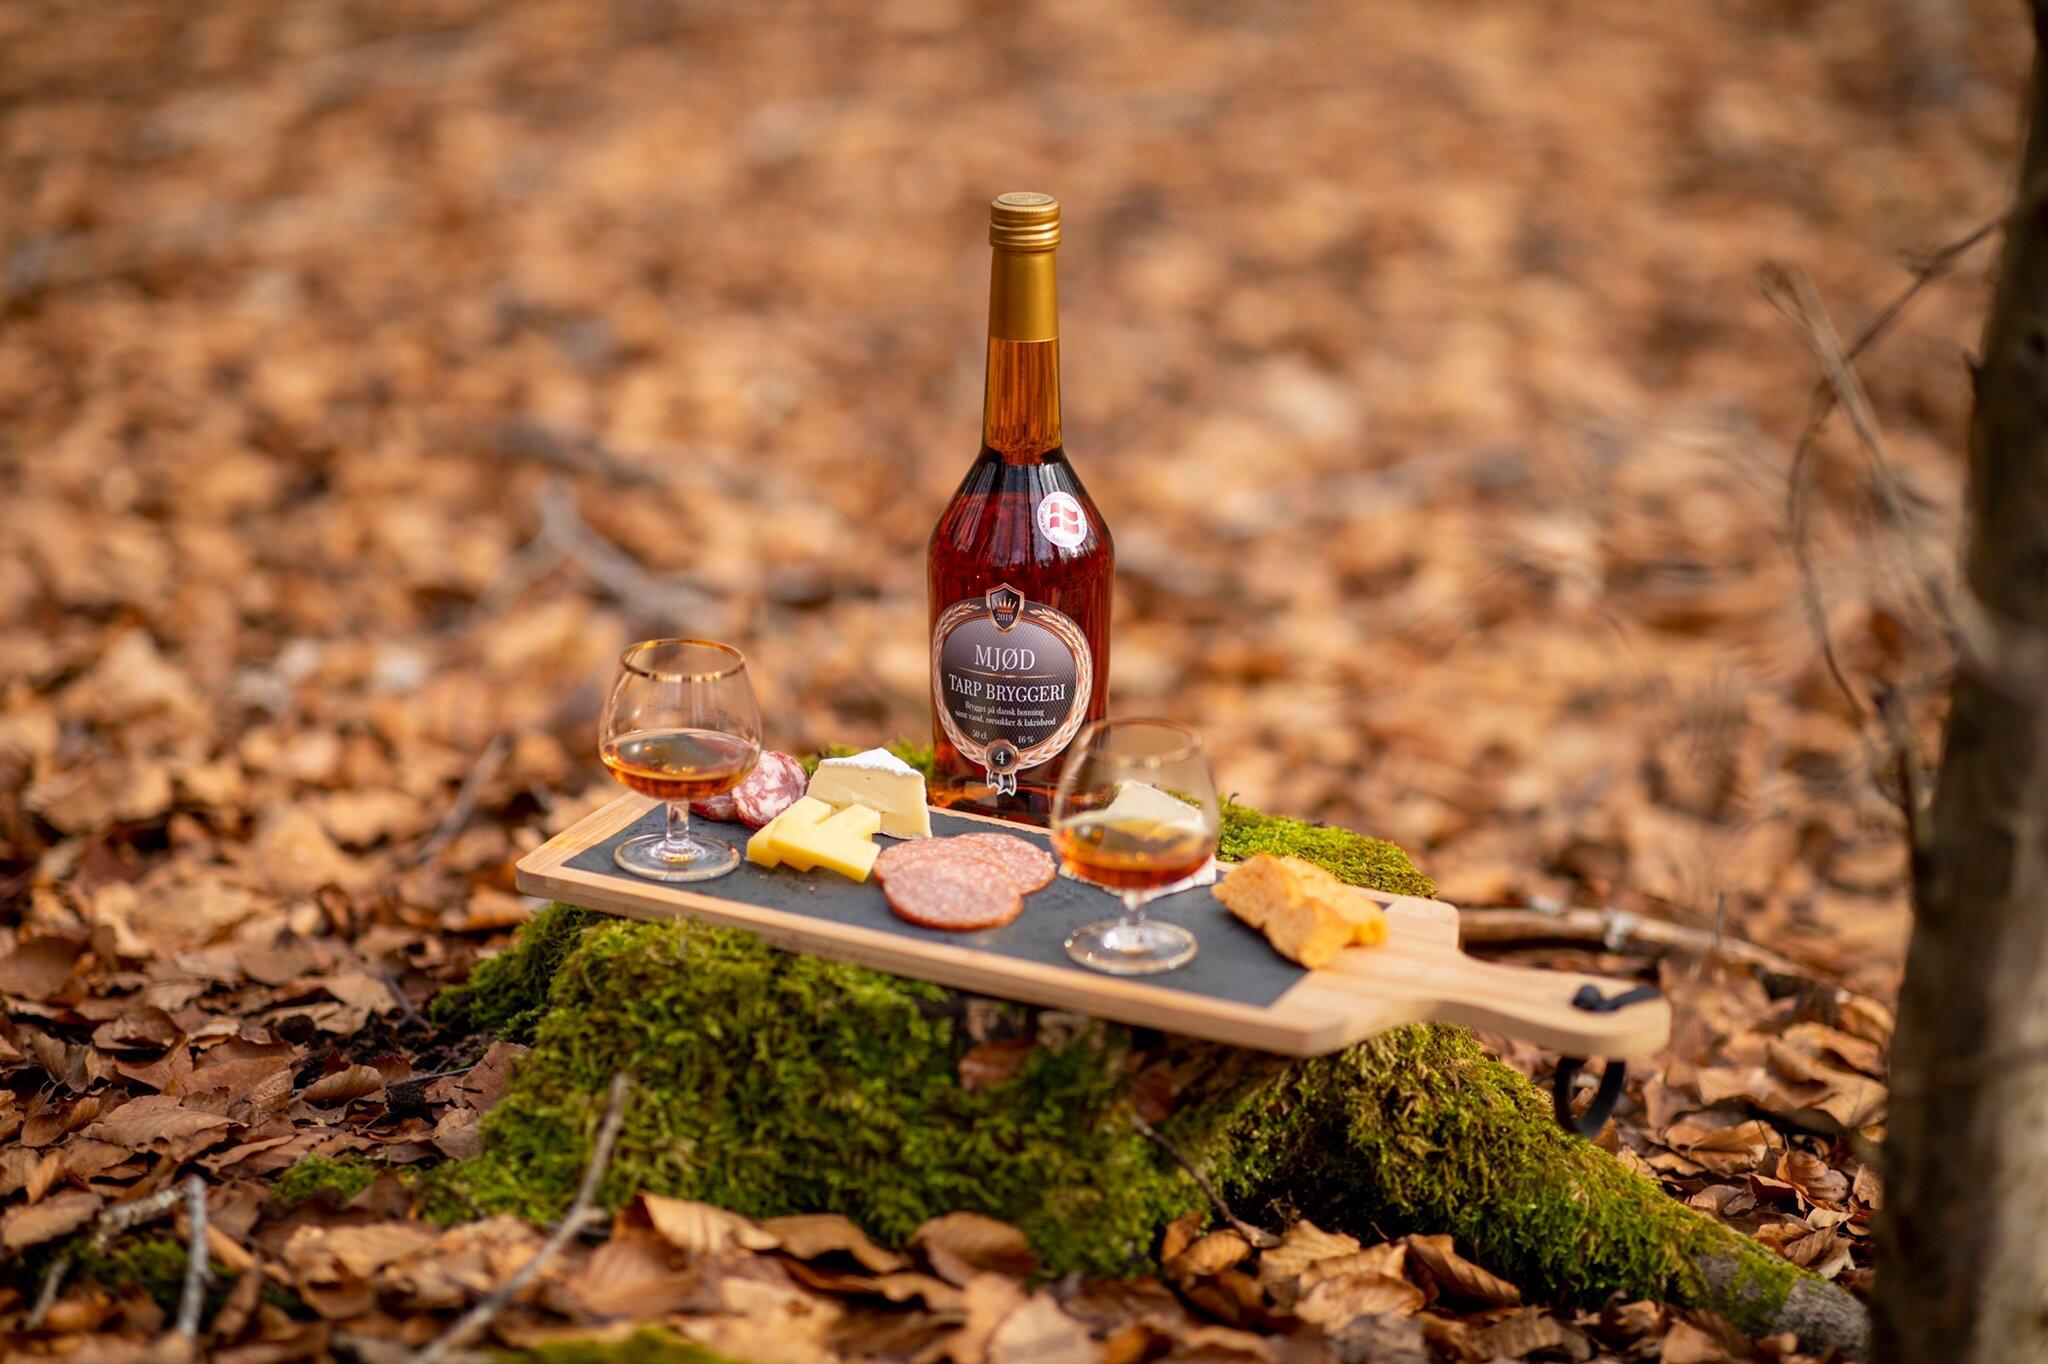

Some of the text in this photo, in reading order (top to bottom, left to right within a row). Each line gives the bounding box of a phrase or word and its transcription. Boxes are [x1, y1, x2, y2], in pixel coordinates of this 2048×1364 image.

[996, 613, 1014, 622] 2019
[974, 644, 1035, 671] MJØD
[948, 673, 1066, 703] TARP BRYGGERI
[987, 706, 995, 714] på
[996, 707, 1015, 715] dansk
[1017, 708, 1045, 717] honning
[972, 730, 980, 738] 50
[1018, 736, 1026, 744] 16
[996, 751, 1005, 764] 4
